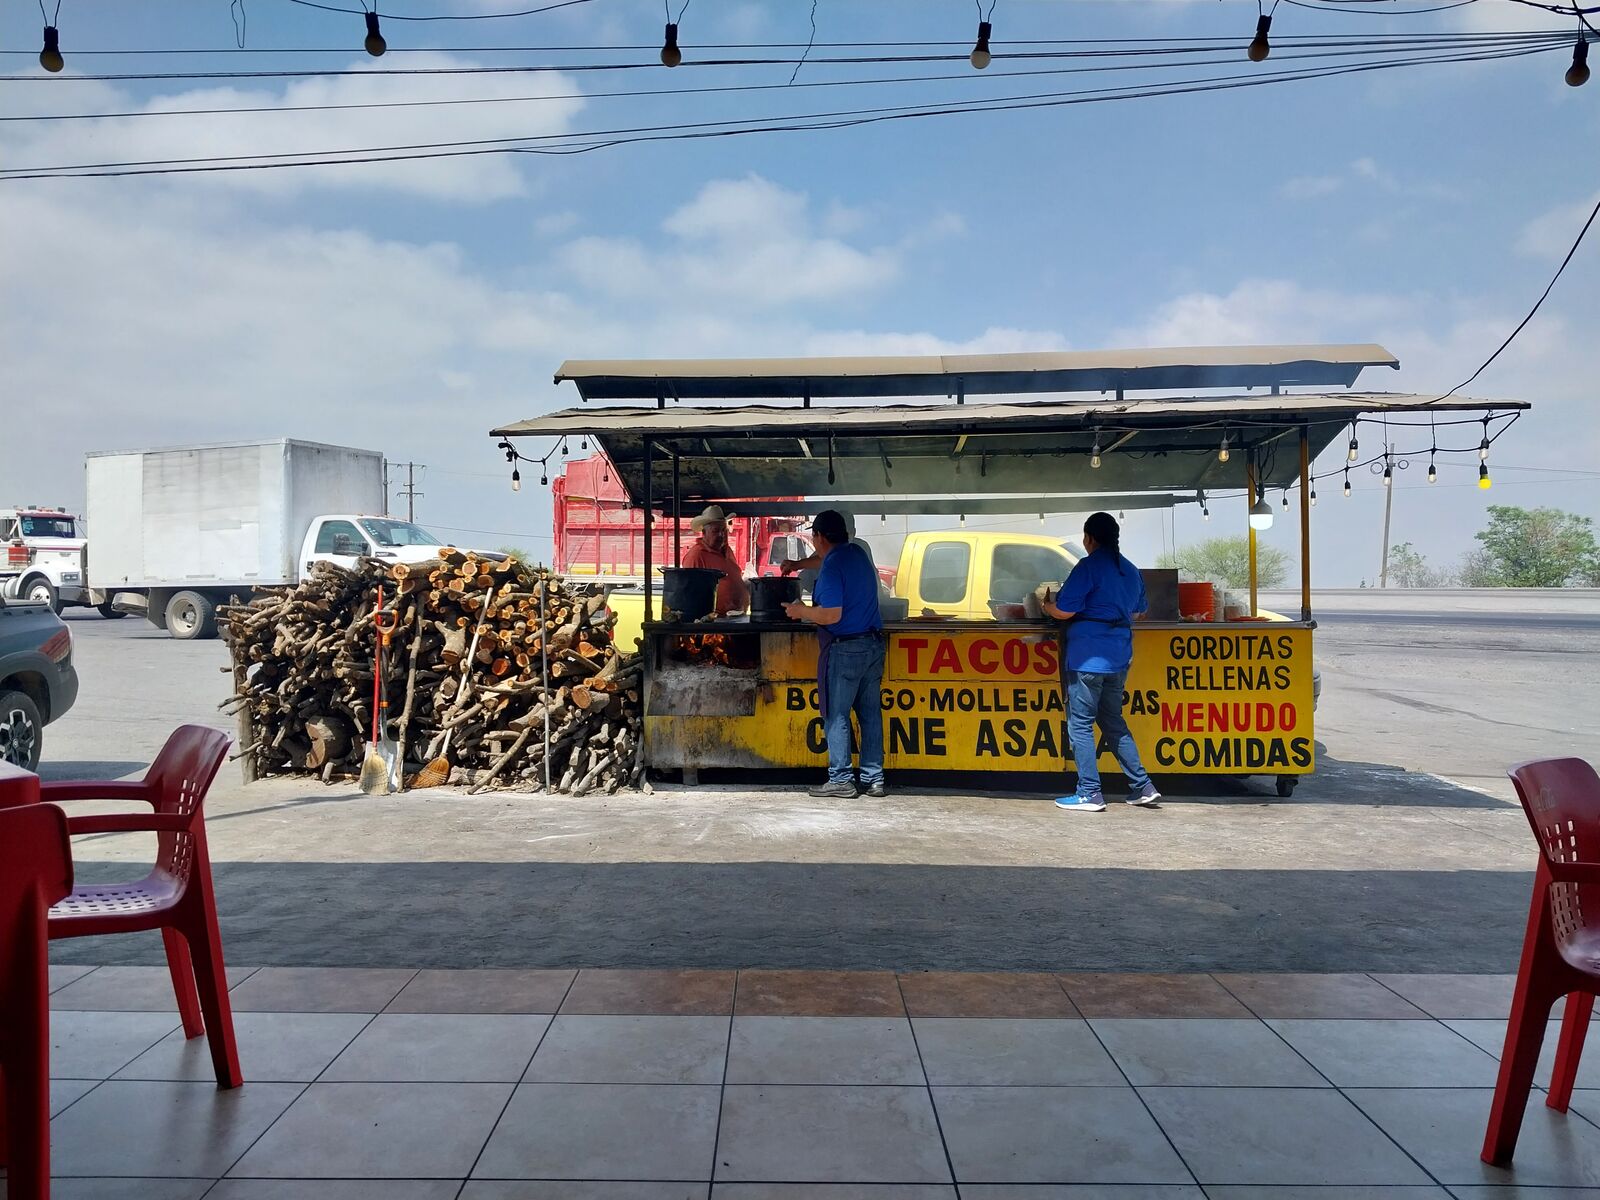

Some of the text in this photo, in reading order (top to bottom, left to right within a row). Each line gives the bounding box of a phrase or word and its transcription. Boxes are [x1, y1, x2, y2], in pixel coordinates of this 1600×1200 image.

[899, 638, 1058, 675] TACOS
[1169, 635, 1294, 660] GORDITAS
[1166, 665, 1292, 691] RELLENAS
[786, 687, 915, 711] BOGO
[929, 688, 1066, 712] MOLLEJA
[1161, 702, 1297, 733] MENUDO
[806, 716, 947, 756] CNE
[1155, 736, 1311, 768] COMIDAS
